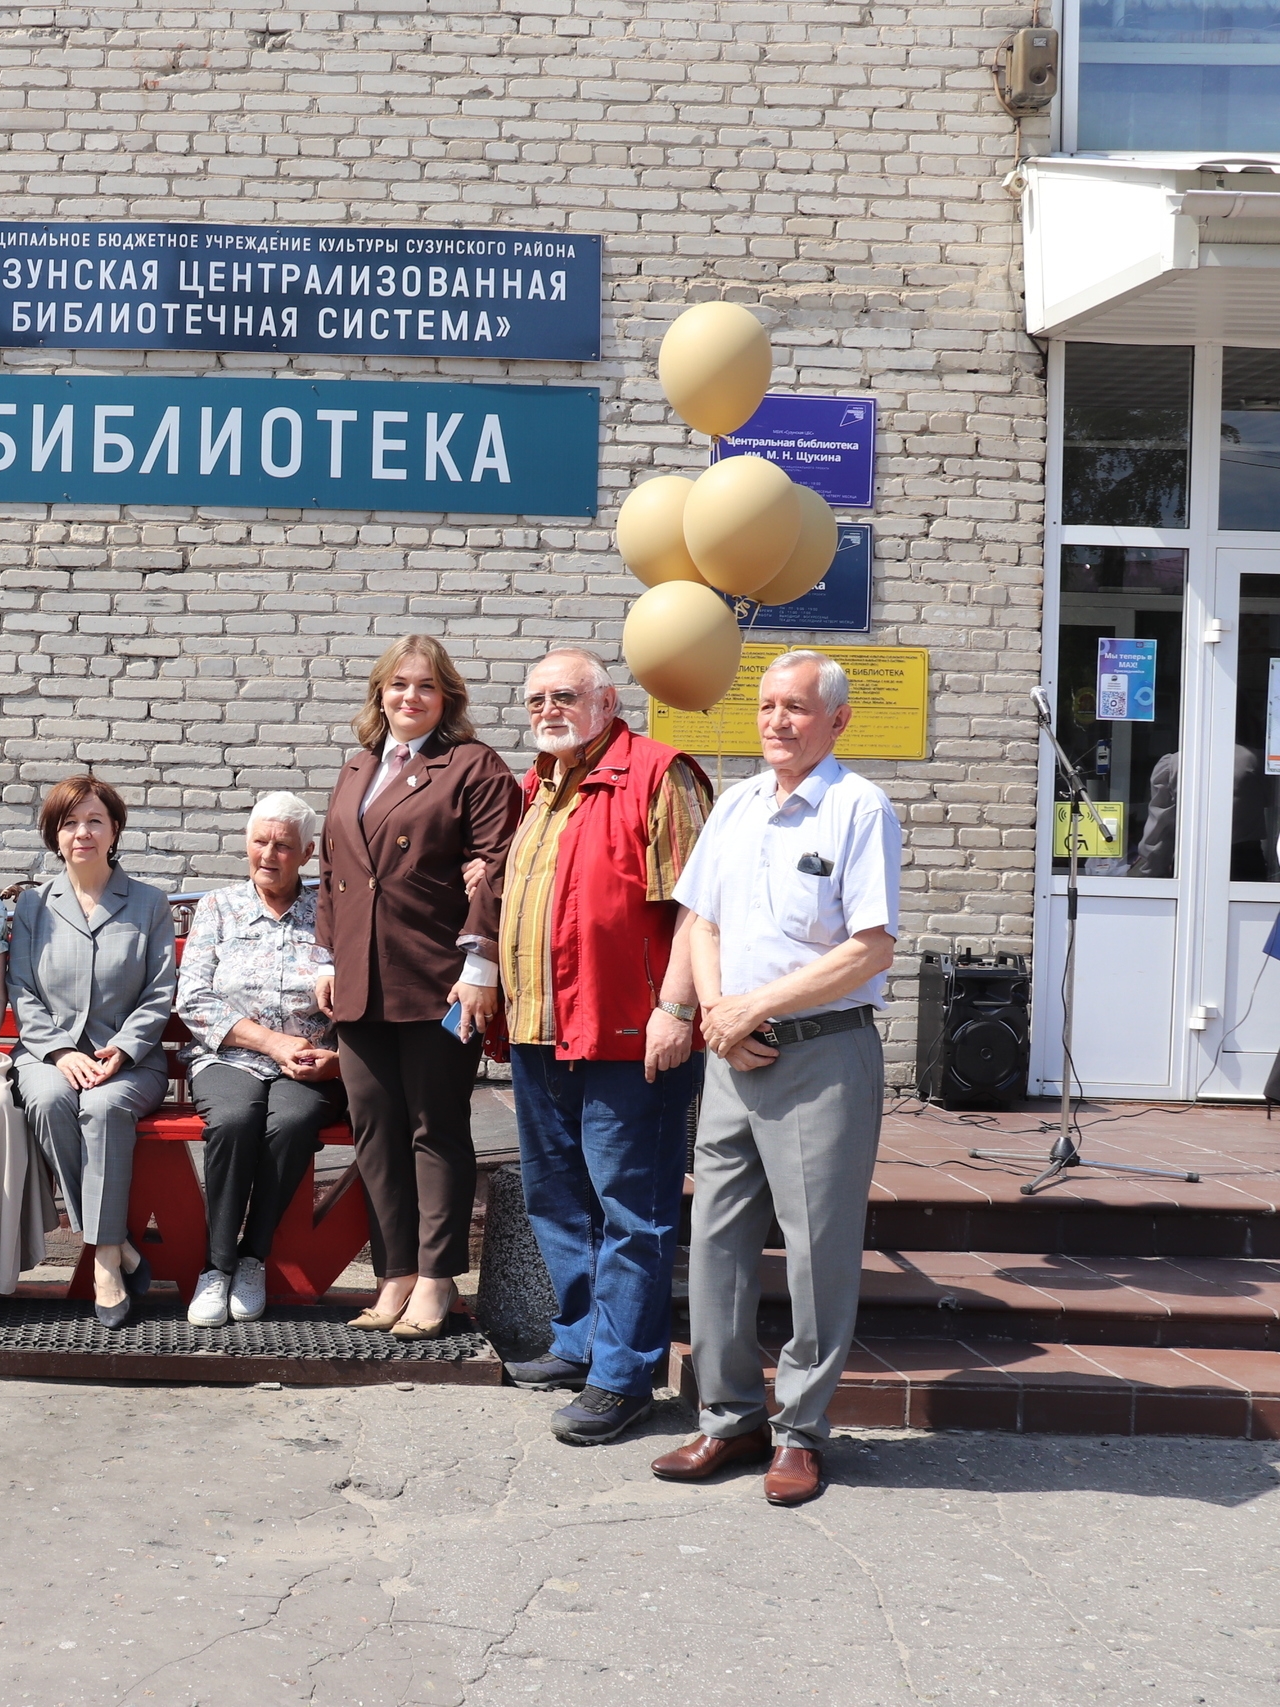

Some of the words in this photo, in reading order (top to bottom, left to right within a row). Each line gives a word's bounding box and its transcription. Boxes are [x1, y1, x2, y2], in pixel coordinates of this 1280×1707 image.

[97, 232, 199, 251] БЮДЖЕТНОЕ
[205, 234, 311, 254] УЧРЕЖДЕНИЕ
[319, 238, 399, 253] КУЛЬТУРЫ
[406, 239, 506, 256] СУЗУНСКОГО
[513, 240, 576, 259] РАЙОНА
[179, 260, 566, 301] ЦЕНТРАЛИЗОВАННАЯ
[12, 301, 298, 338] БИБЛИОТЕЧНАЯ
[318, 307, 511, 342] СИСТЕМА»
[727, 435, 795, 449] Центральная
[796, 437, 859, 451] библиотека
[766, 451, 780, 461] М.
[782, 451, 793, 462] Н.
[796, 452, 841, 464] Щукина
[1120, 653, 1146, 661] теперь
[852, 668, 905, 677] БИБЛИОТЕКА
